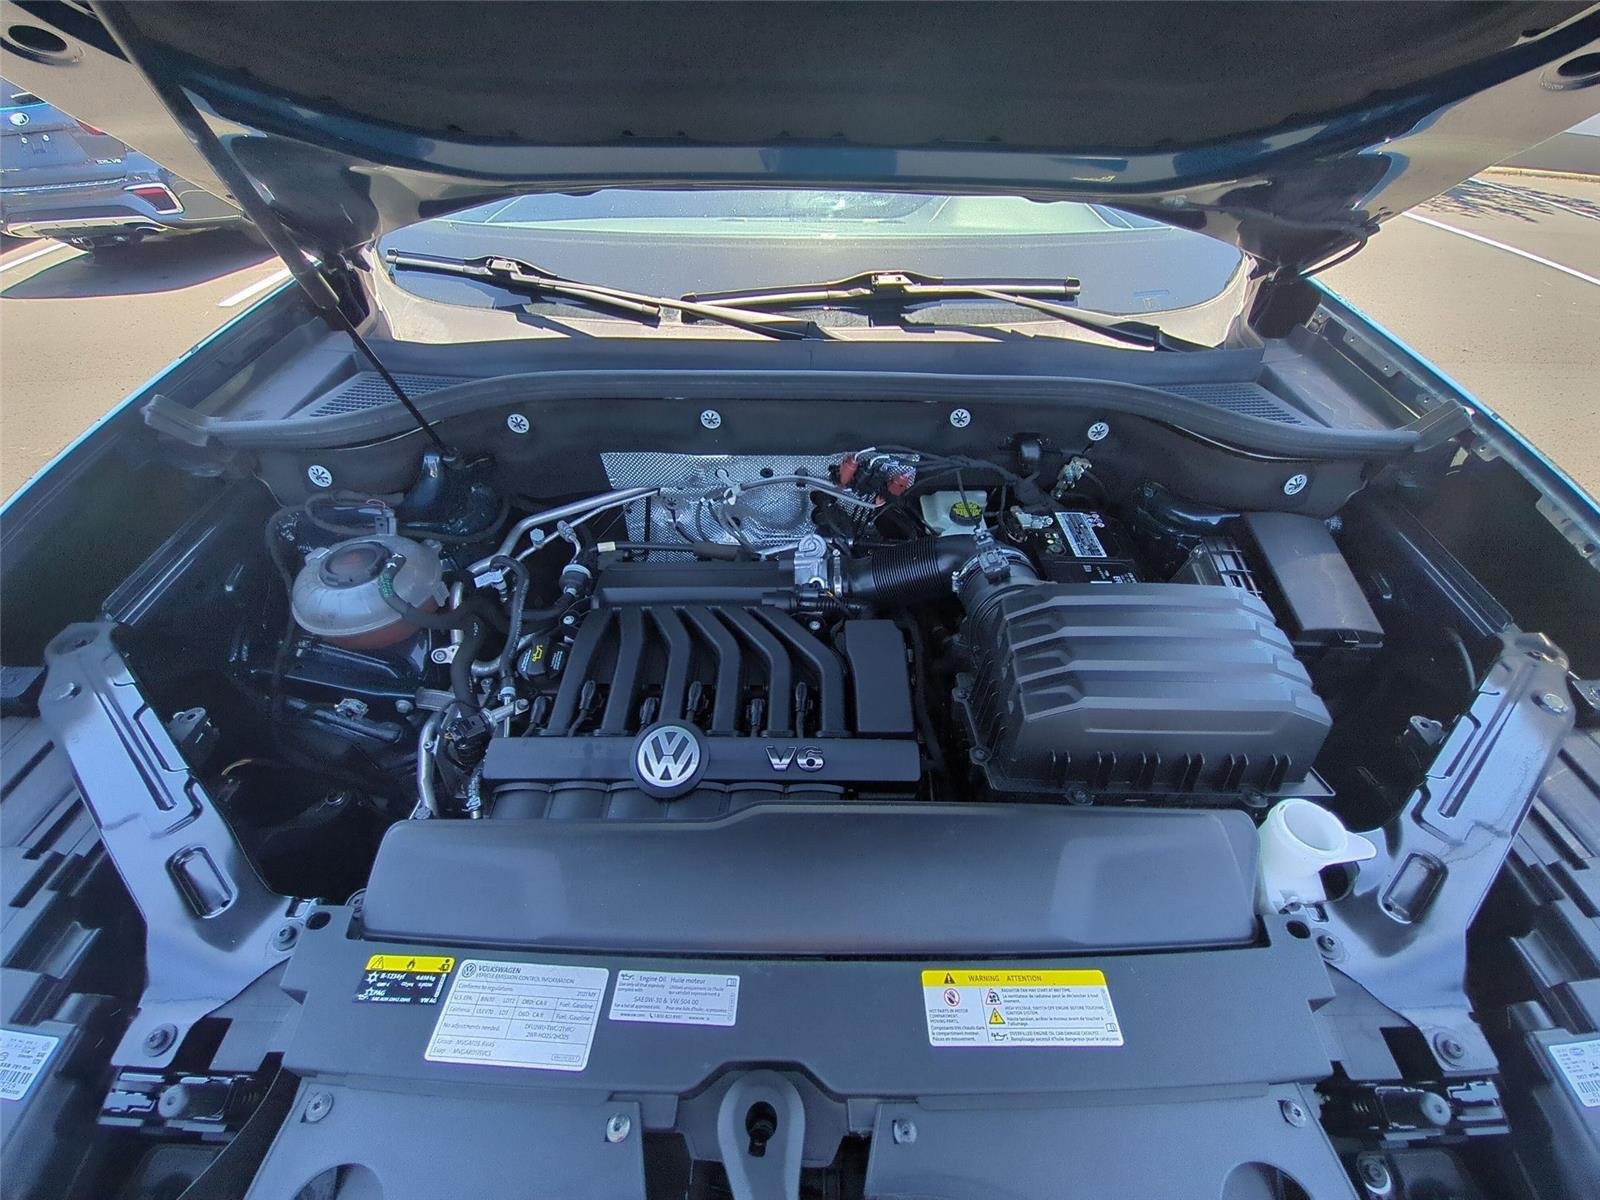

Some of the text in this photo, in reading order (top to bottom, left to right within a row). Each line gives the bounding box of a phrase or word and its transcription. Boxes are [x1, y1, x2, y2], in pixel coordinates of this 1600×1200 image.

[765, 745, 825, 773] V6
[478, 965, 522, 974] VOLKSWAGEN
[639, 975, 658, 983] Engine
[968, 975, 1042, 983] WARNING ATTENTION
